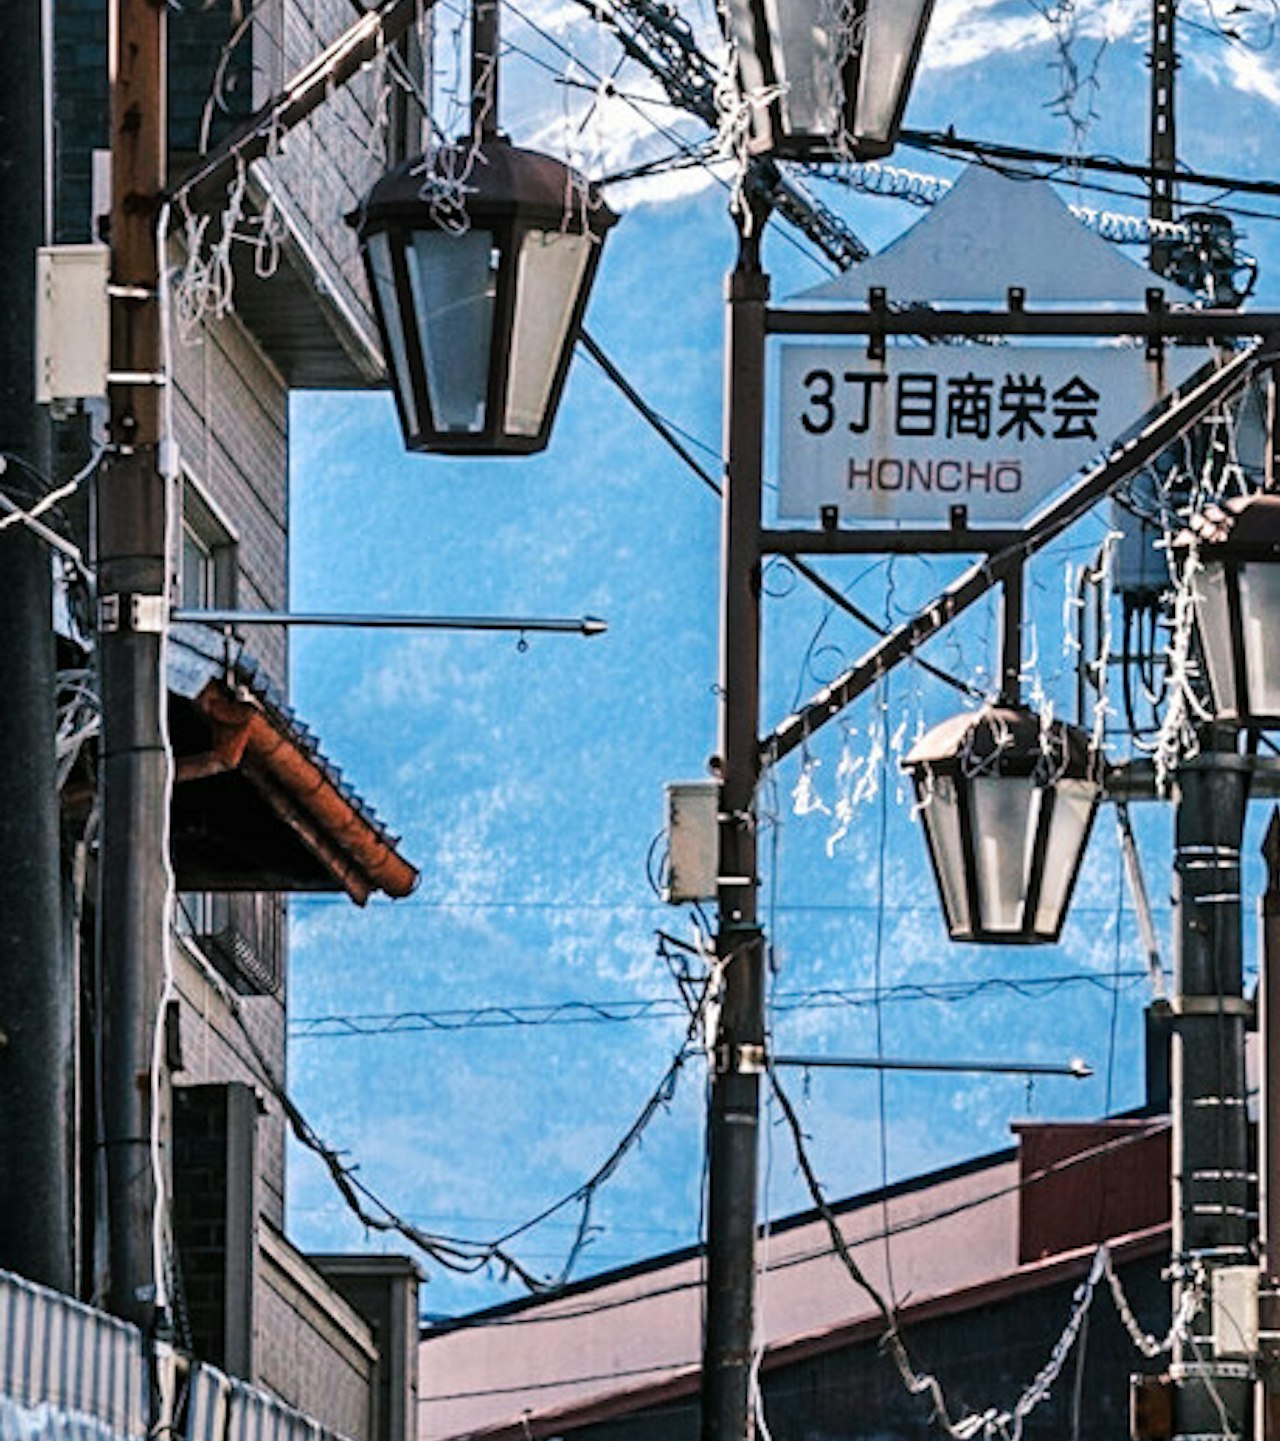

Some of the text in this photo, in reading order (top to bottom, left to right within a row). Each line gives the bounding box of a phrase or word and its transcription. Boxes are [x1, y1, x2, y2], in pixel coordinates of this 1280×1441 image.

[801, 369, 1100, 442] 3丁目商栄会
